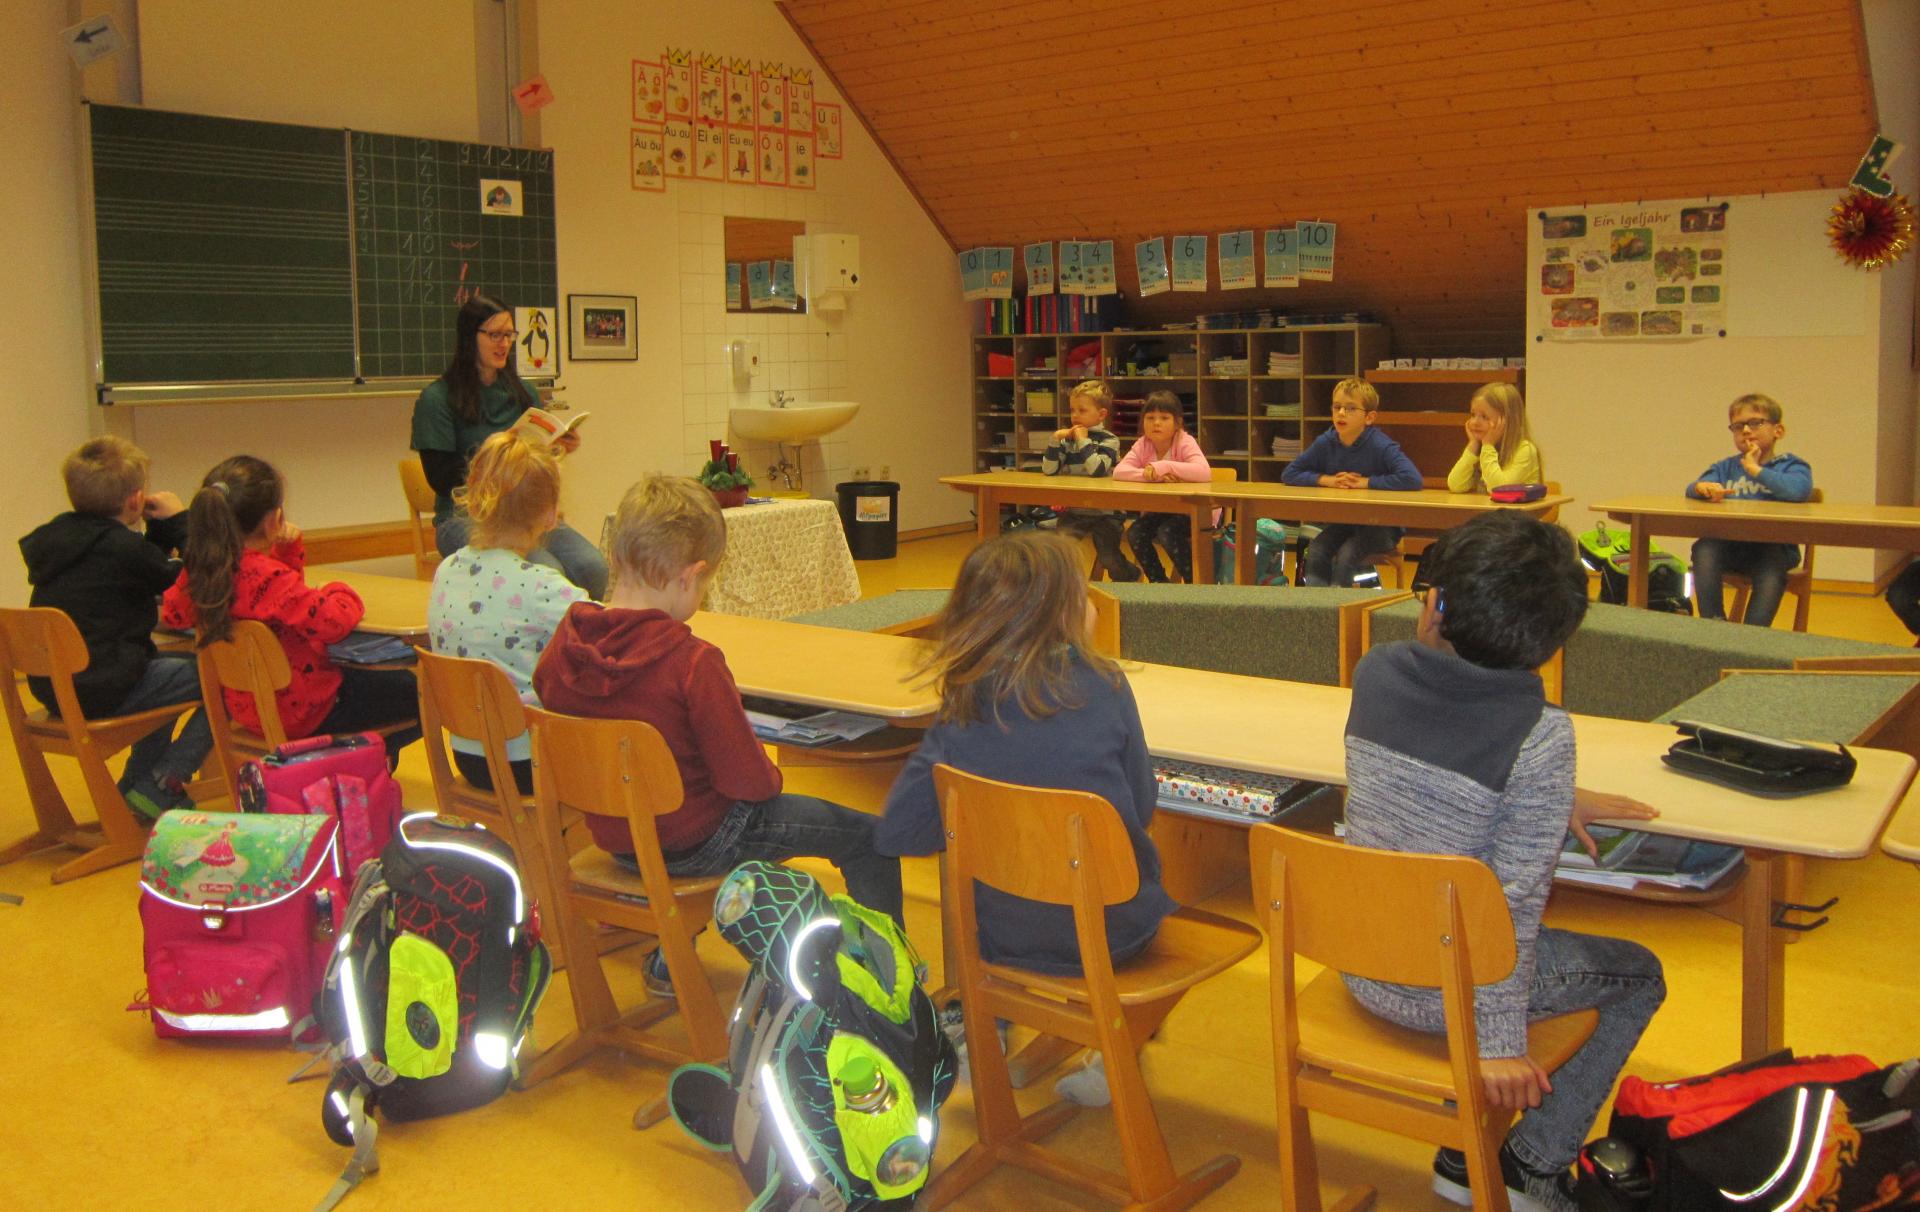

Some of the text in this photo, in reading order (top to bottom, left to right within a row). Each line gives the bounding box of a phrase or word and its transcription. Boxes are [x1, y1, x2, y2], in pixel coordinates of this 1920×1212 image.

[701, 70, 721, 87] E e
[664, 126, 677, 137] Au
[697, 129, 722, 144] Ei ei
[729, 134, 753, 146] Eu eu
[796, 141, 806, 155] ie
[1593, 211, 1671, 228] Ein Igeljahr
[1276, 233, 1286, 253] 9
[1303, 225, 1328, 246] 10
[1072, 244, 1080, 262] 3
[1147, 243, 1155, 262] 5
[1185, 239, 1194, 258] 6
[1232, 235, 1241, 254] 7
[967, 252, 977, 270] 0
[994, 250, 1001, 267] 1
[1034, 246, 1043, 264] 2
[1092, 245, 1101, 262] 4
